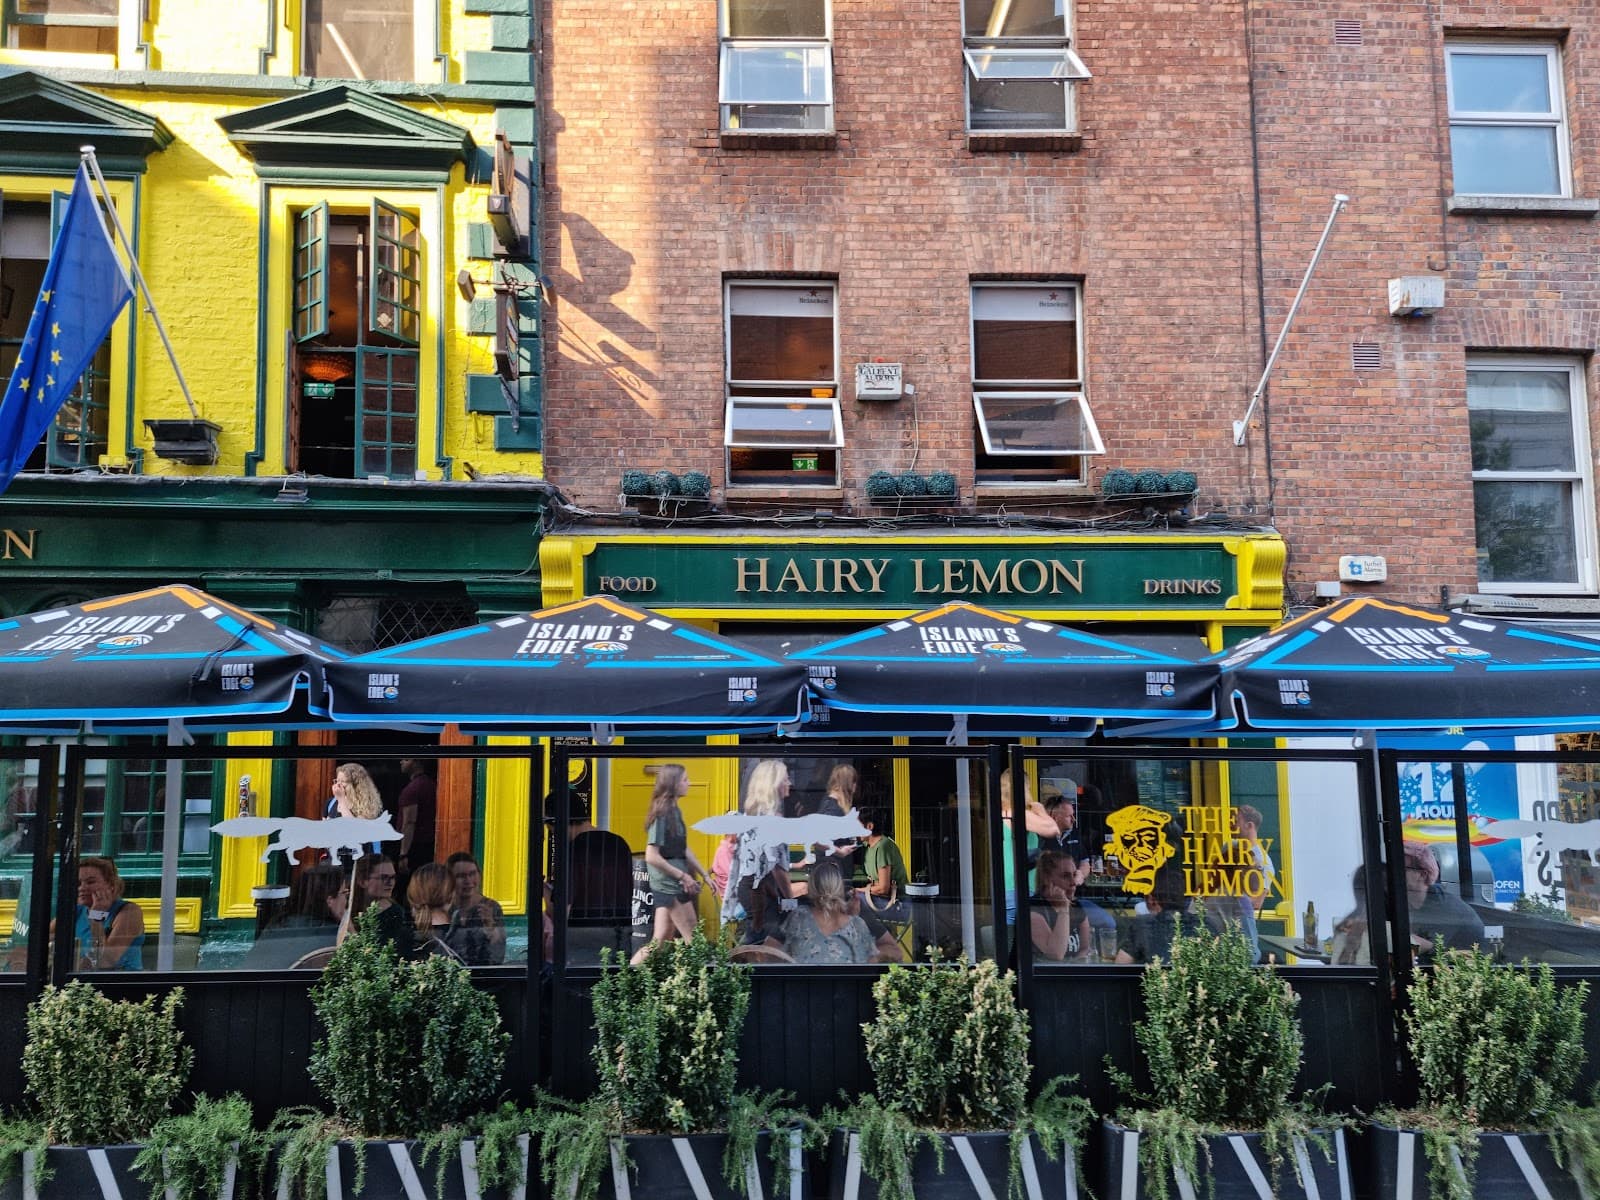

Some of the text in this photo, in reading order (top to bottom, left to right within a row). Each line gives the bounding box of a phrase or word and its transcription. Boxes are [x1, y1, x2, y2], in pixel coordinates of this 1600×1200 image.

[600, 576, 656, 592] FOOD
[733, 557, 1086, 594] HAIRY LEMON
[1143, 579, 1222, 595] DRINKS
[53, 613, 187, 635] ISLAND'S
[527, 622, 635, 641] ISLAND'S
[919, 626, 1021, 643] ISLAND'S
[1344, 626, 1470, 645] ISLAND'S
[516, 639, 580, 654] EDGE
[923, 641, 981, 654] EDGE
[1178, 807, 1241, 834] THE
[1414, 804, 1456, 820] HOU
[1181, 837, 1274, 867] HAIRY
[1182, 868, 1288, 898] LEMON
